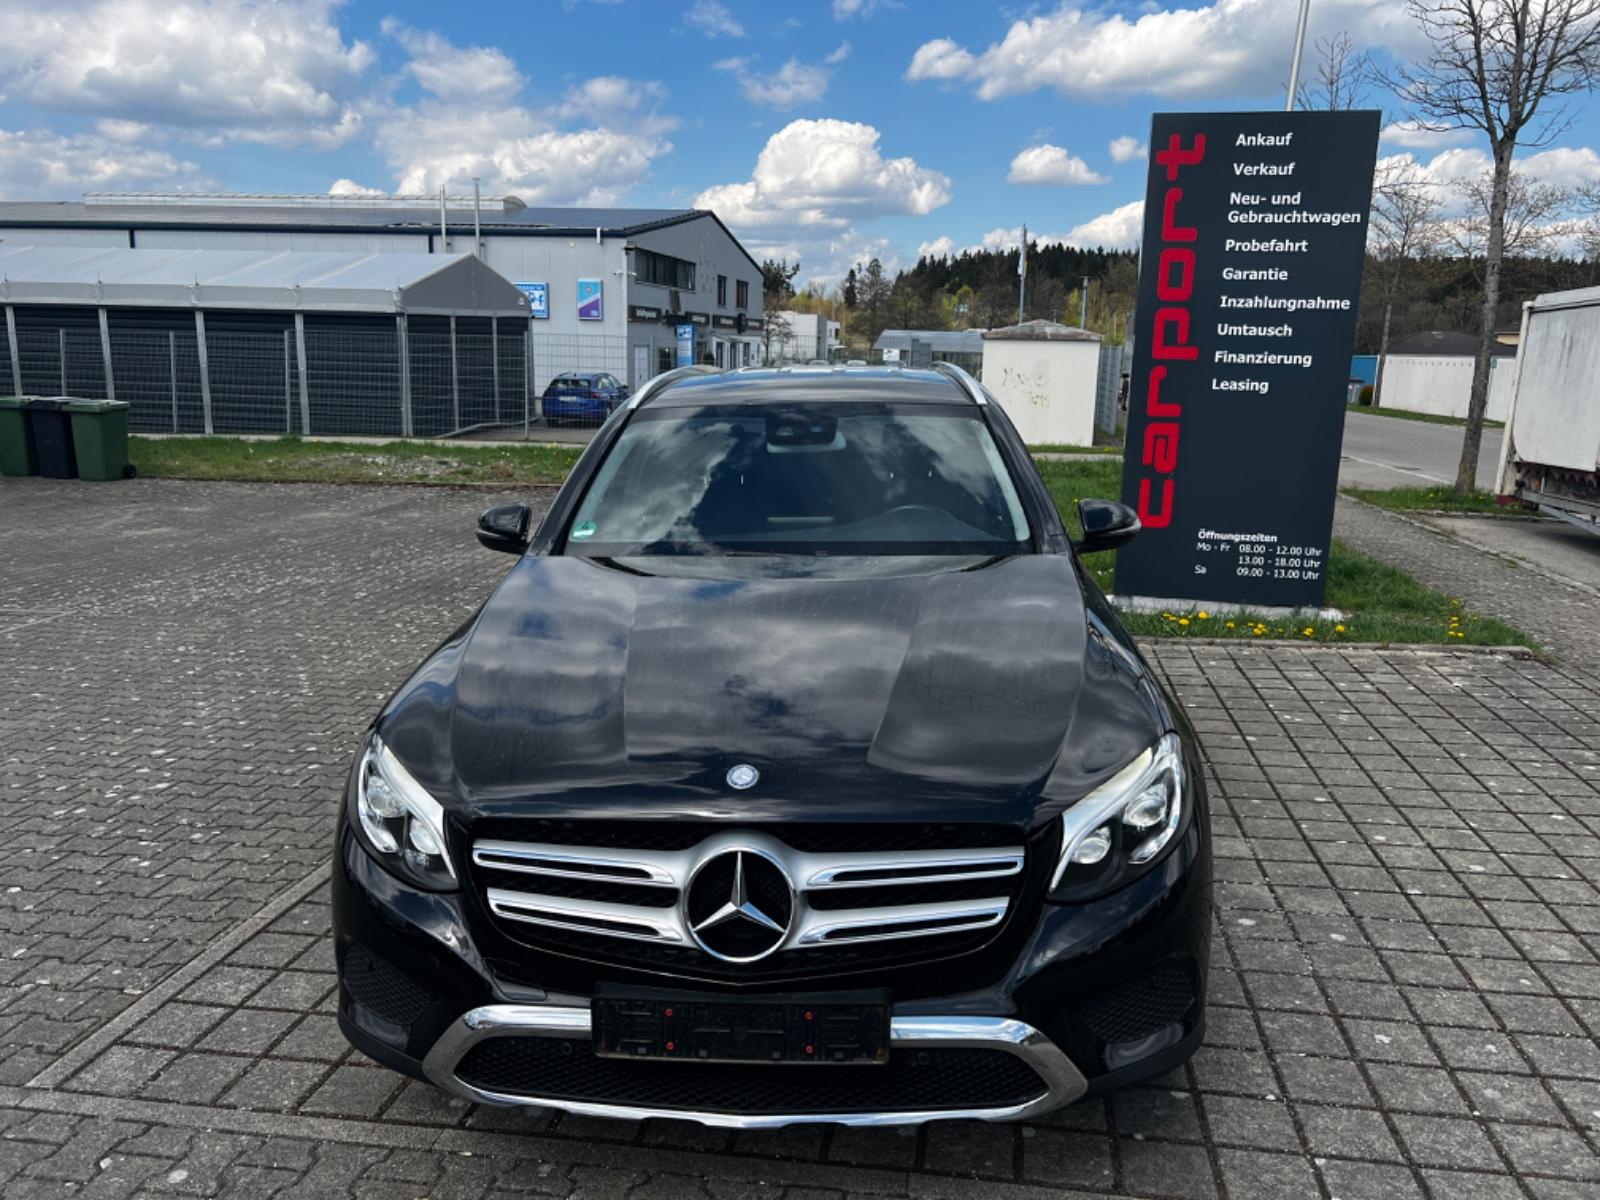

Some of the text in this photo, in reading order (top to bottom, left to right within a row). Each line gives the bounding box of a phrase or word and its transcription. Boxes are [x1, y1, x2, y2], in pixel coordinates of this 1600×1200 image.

[1235, 132, 1294, 147] Ankauf
[1233, 162, 1295, 176] Verkauf
[1229, 192, 1302, 206] Neu- und
[1227, 210, 1362, 226] Gebrauchtwagen
[1224, 239, 1309, 253] Probefahrt
[1222, 268, 1289, 281] Garantie
[1219, 296, 1351, 312] Inzahlungnahme
[1138, 132, 1207, 529] carport
[1216, 323, 1293, 338] Umtausch
[1213, 351, 1313, 367] Finanzierung
[1211, 378, 1270, 394] Leasing
[1198, 529, 1278, 543] Öffnungszeiten
[1196, 542, 1212, 552] Mo
[1220, 542, 1231, 552] Fr
[1239, 544, 1266, 554] 08.00
[1276, 545, 1303, 556] 12.00
[1304, 547, 1322, 556] Uhr
[1238, 556, 1265, 565] 13.00
[1303, 558, 1321, 568] Uhr
[1194, 564, 1207, 574] Sa
[1235, 567, 1264, 577] 09.00
[1273, 569, 1300, 579] 13.00
[1302, 570, 1320, 580] Uhr
